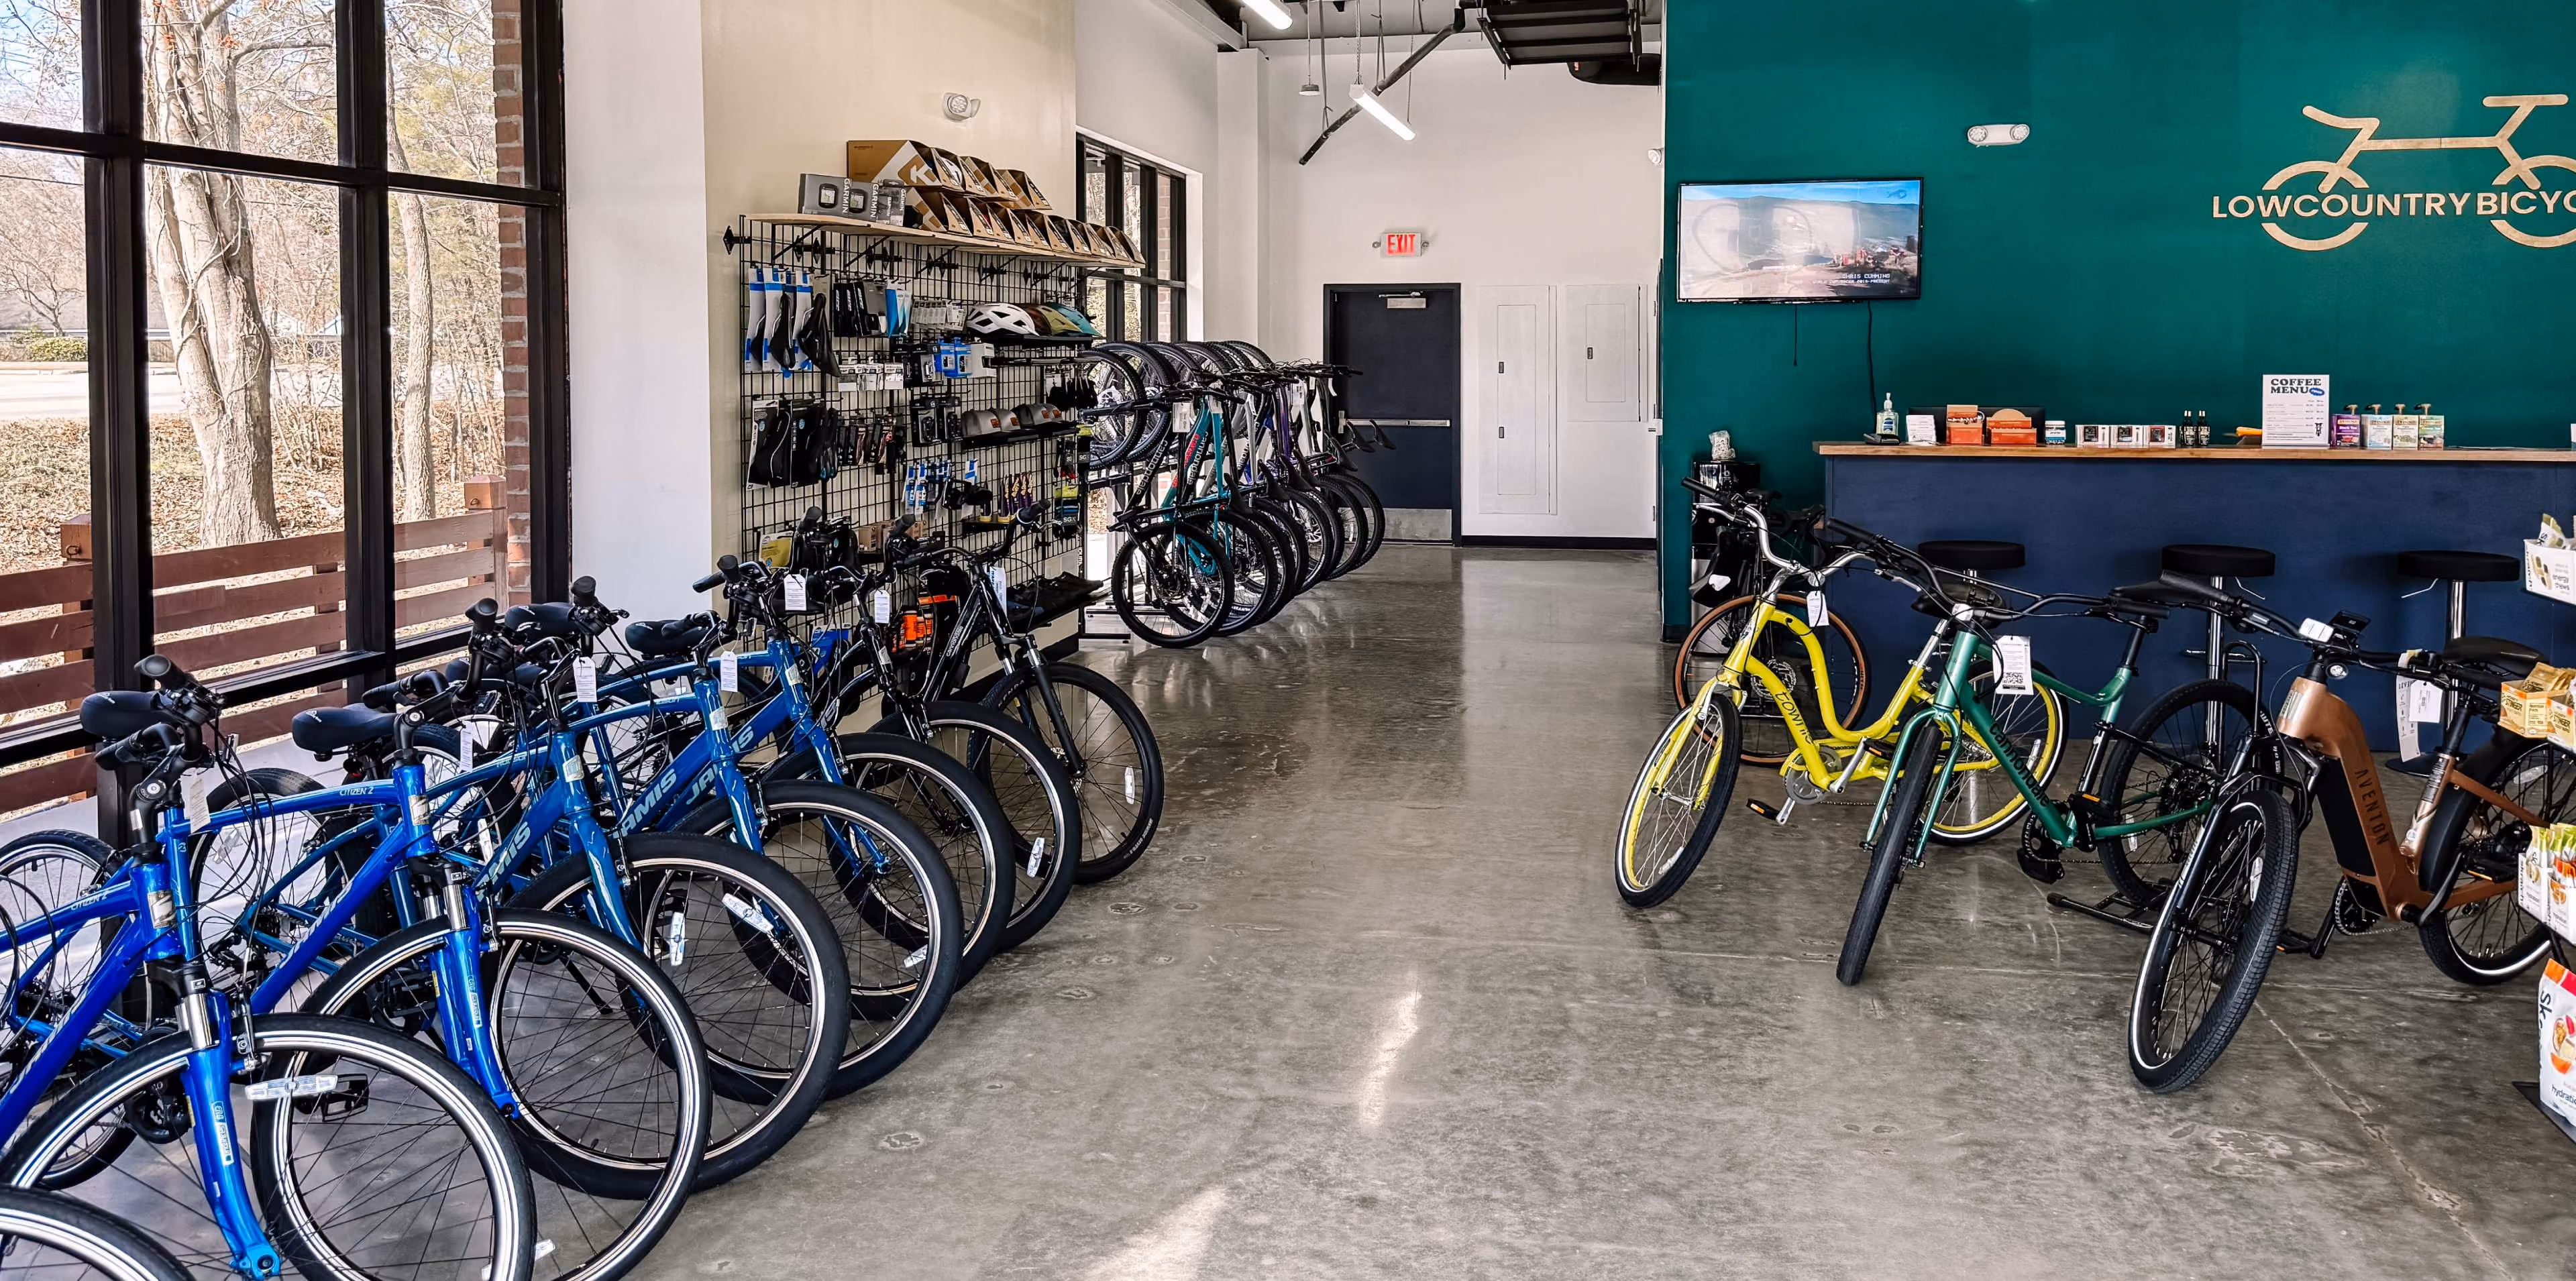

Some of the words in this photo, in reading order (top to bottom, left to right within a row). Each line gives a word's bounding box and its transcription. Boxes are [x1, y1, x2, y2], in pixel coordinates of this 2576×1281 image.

[842, 178, 850, 214] GARMIN
[870, 184, 879, 219] GARMIN
[2212, 192, 2471, 219] LOWCOUNTRY
[1387, 233, 1416, 256] EXIT
[2270, 378, 2322, 386] COFFEE
[2270, 386, 2309, 394] MENU
[1136, 439, 1169, 495] cannondale
[1187, 431, 1209, 486] cannondale
[946, 625, 964, 657] cannondale
[686, 724, 755, 805] JAIS
[1989, 720, 2051, 807] cannondale
[339, 787, 367, 796] CITIZEN
[368, 786, 374, 795] 2
[2355, 769, 2391, 846] AVENTON
[70, 895, 100, 911] CITIZEN
